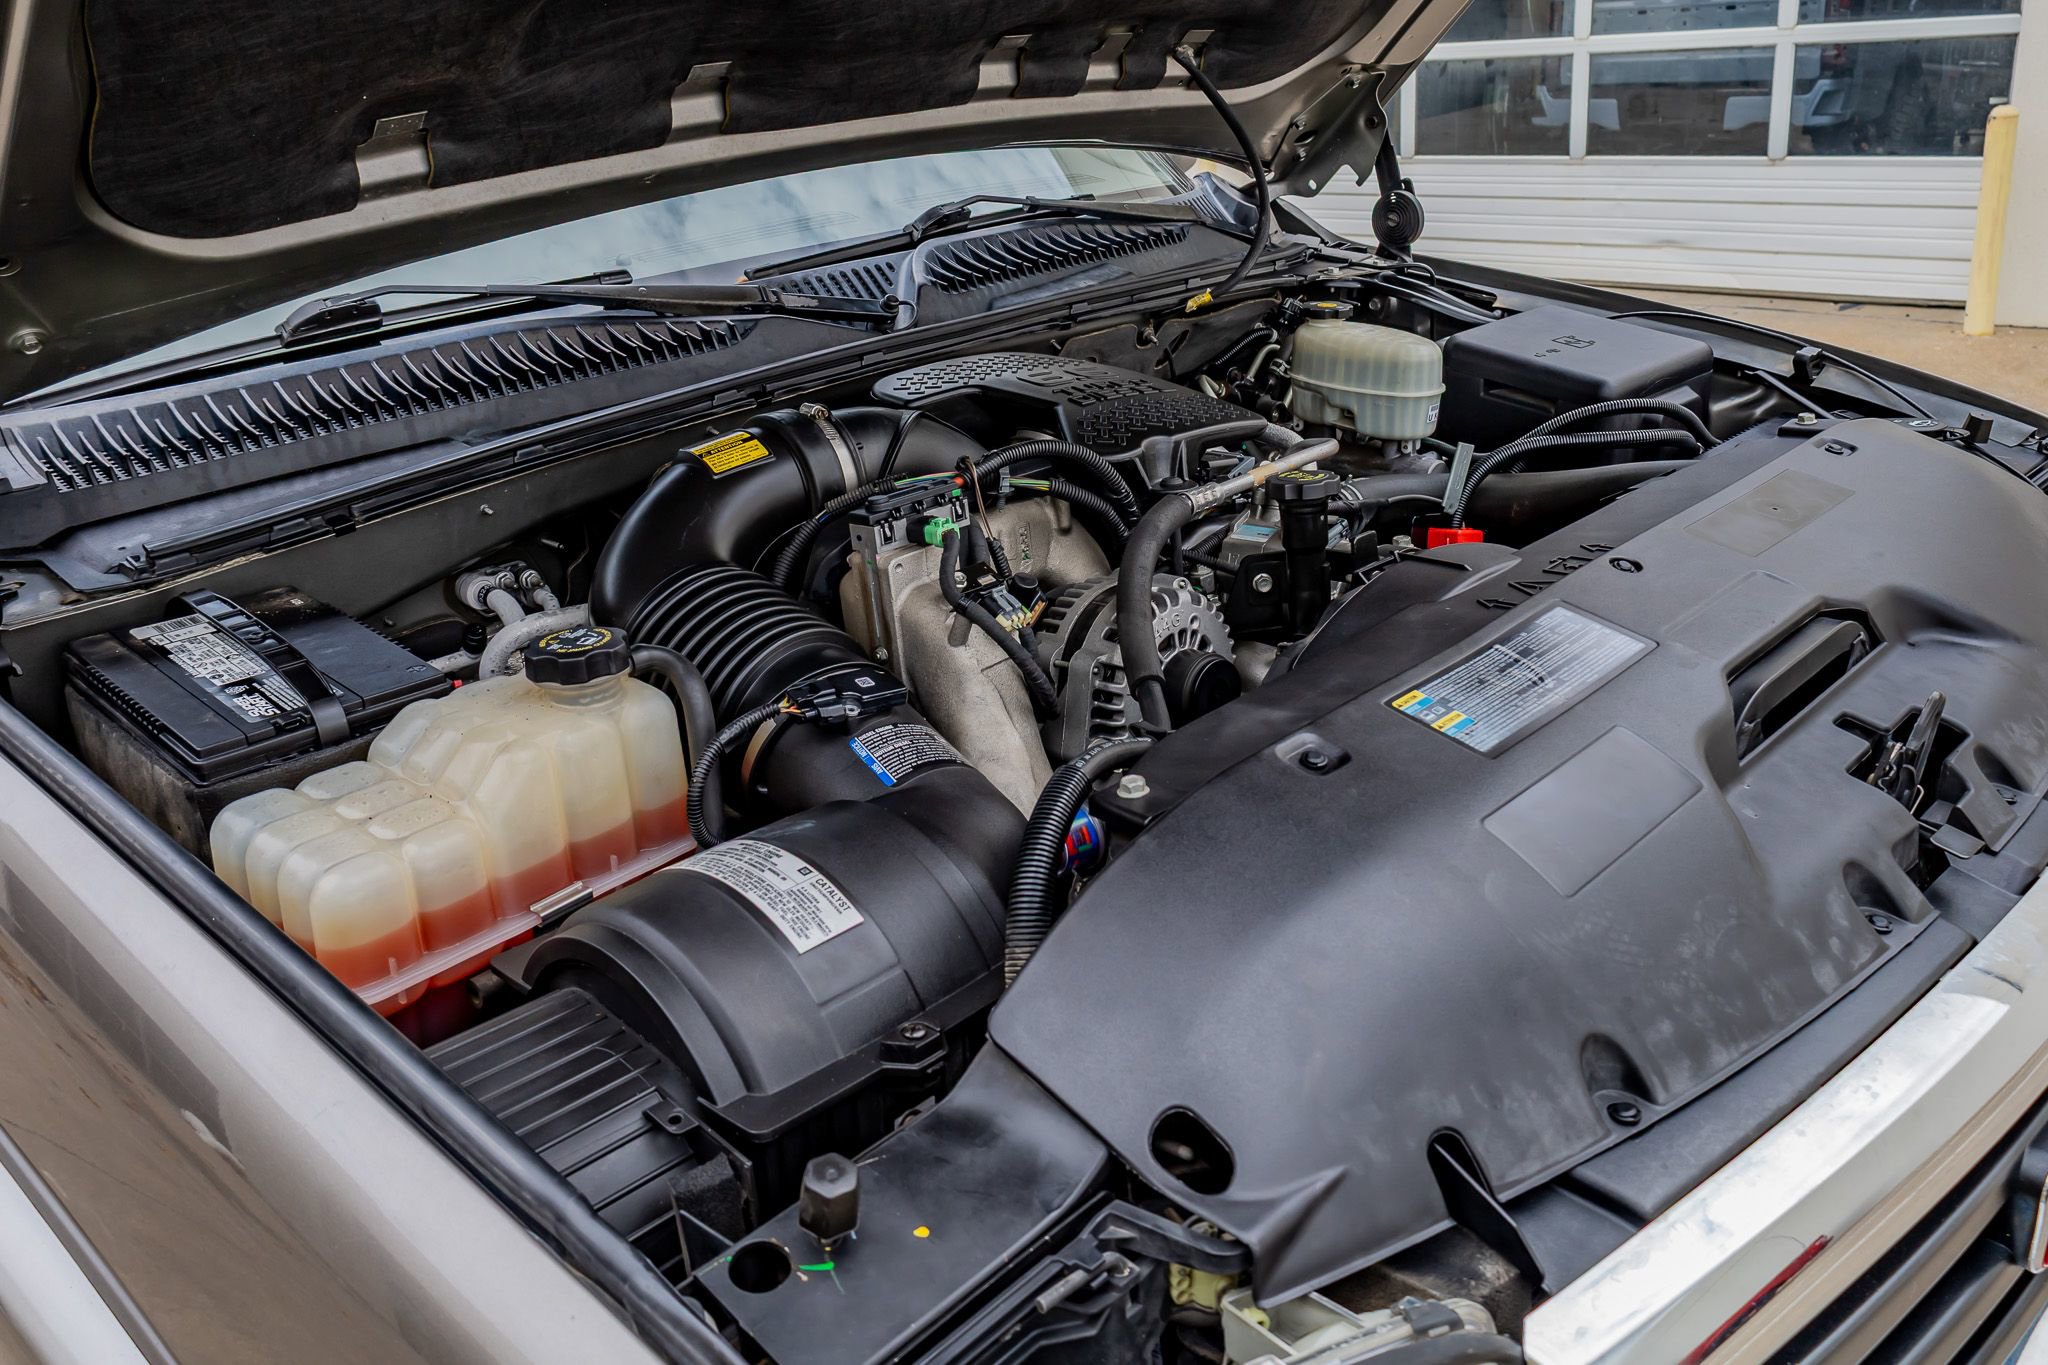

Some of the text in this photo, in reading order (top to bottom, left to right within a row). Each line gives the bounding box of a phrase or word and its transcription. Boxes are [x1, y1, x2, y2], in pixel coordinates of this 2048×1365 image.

[233, 696, 262, 717] SUPER
[244, 692, 280, 716] START
[815, 878, 851, 912] CATALYST
